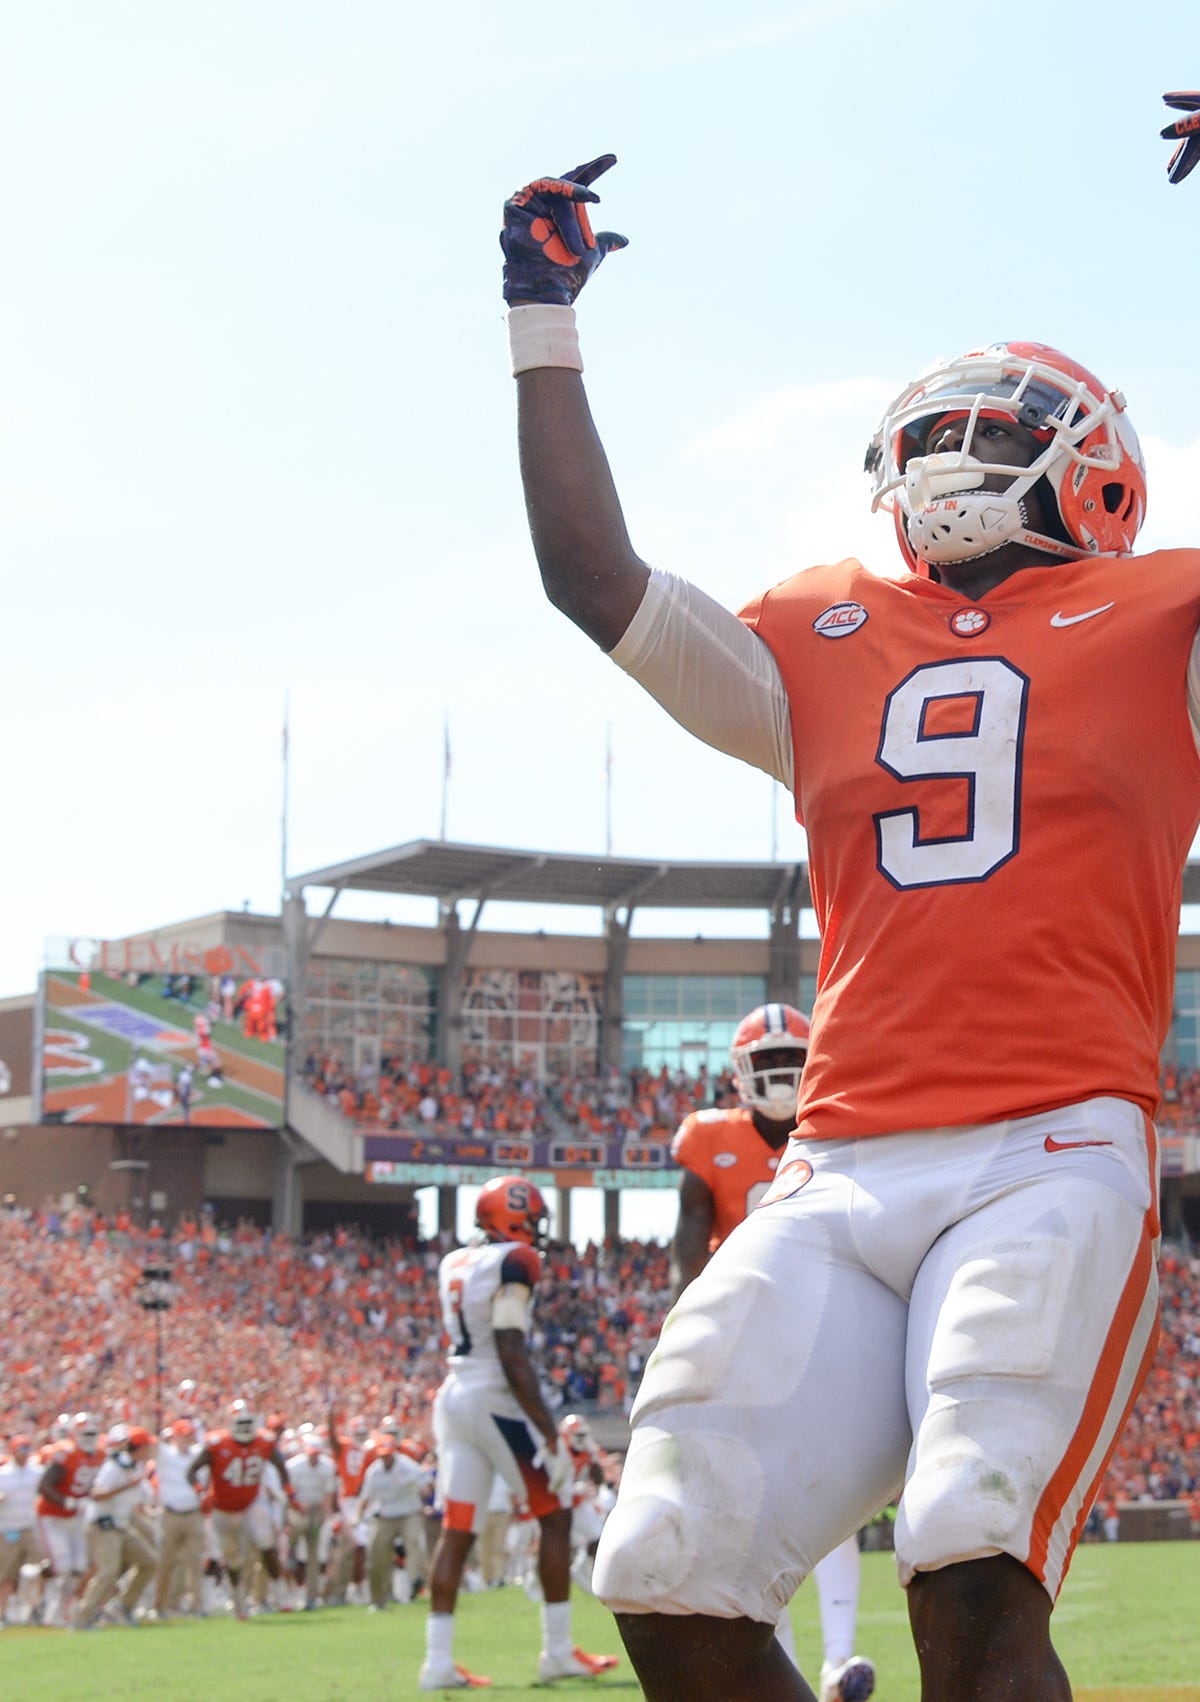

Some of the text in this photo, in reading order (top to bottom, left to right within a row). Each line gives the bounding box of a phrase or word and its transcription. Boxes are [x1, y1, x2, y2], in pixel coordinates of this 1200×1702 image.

[944, 500, 957, 511] IN
[820, 608, 861, 627] ACC
[872, 655, 1031, 892] 9
[507, 1184, 529, 1211] S
[223, 1456, 264, 1488] 42
